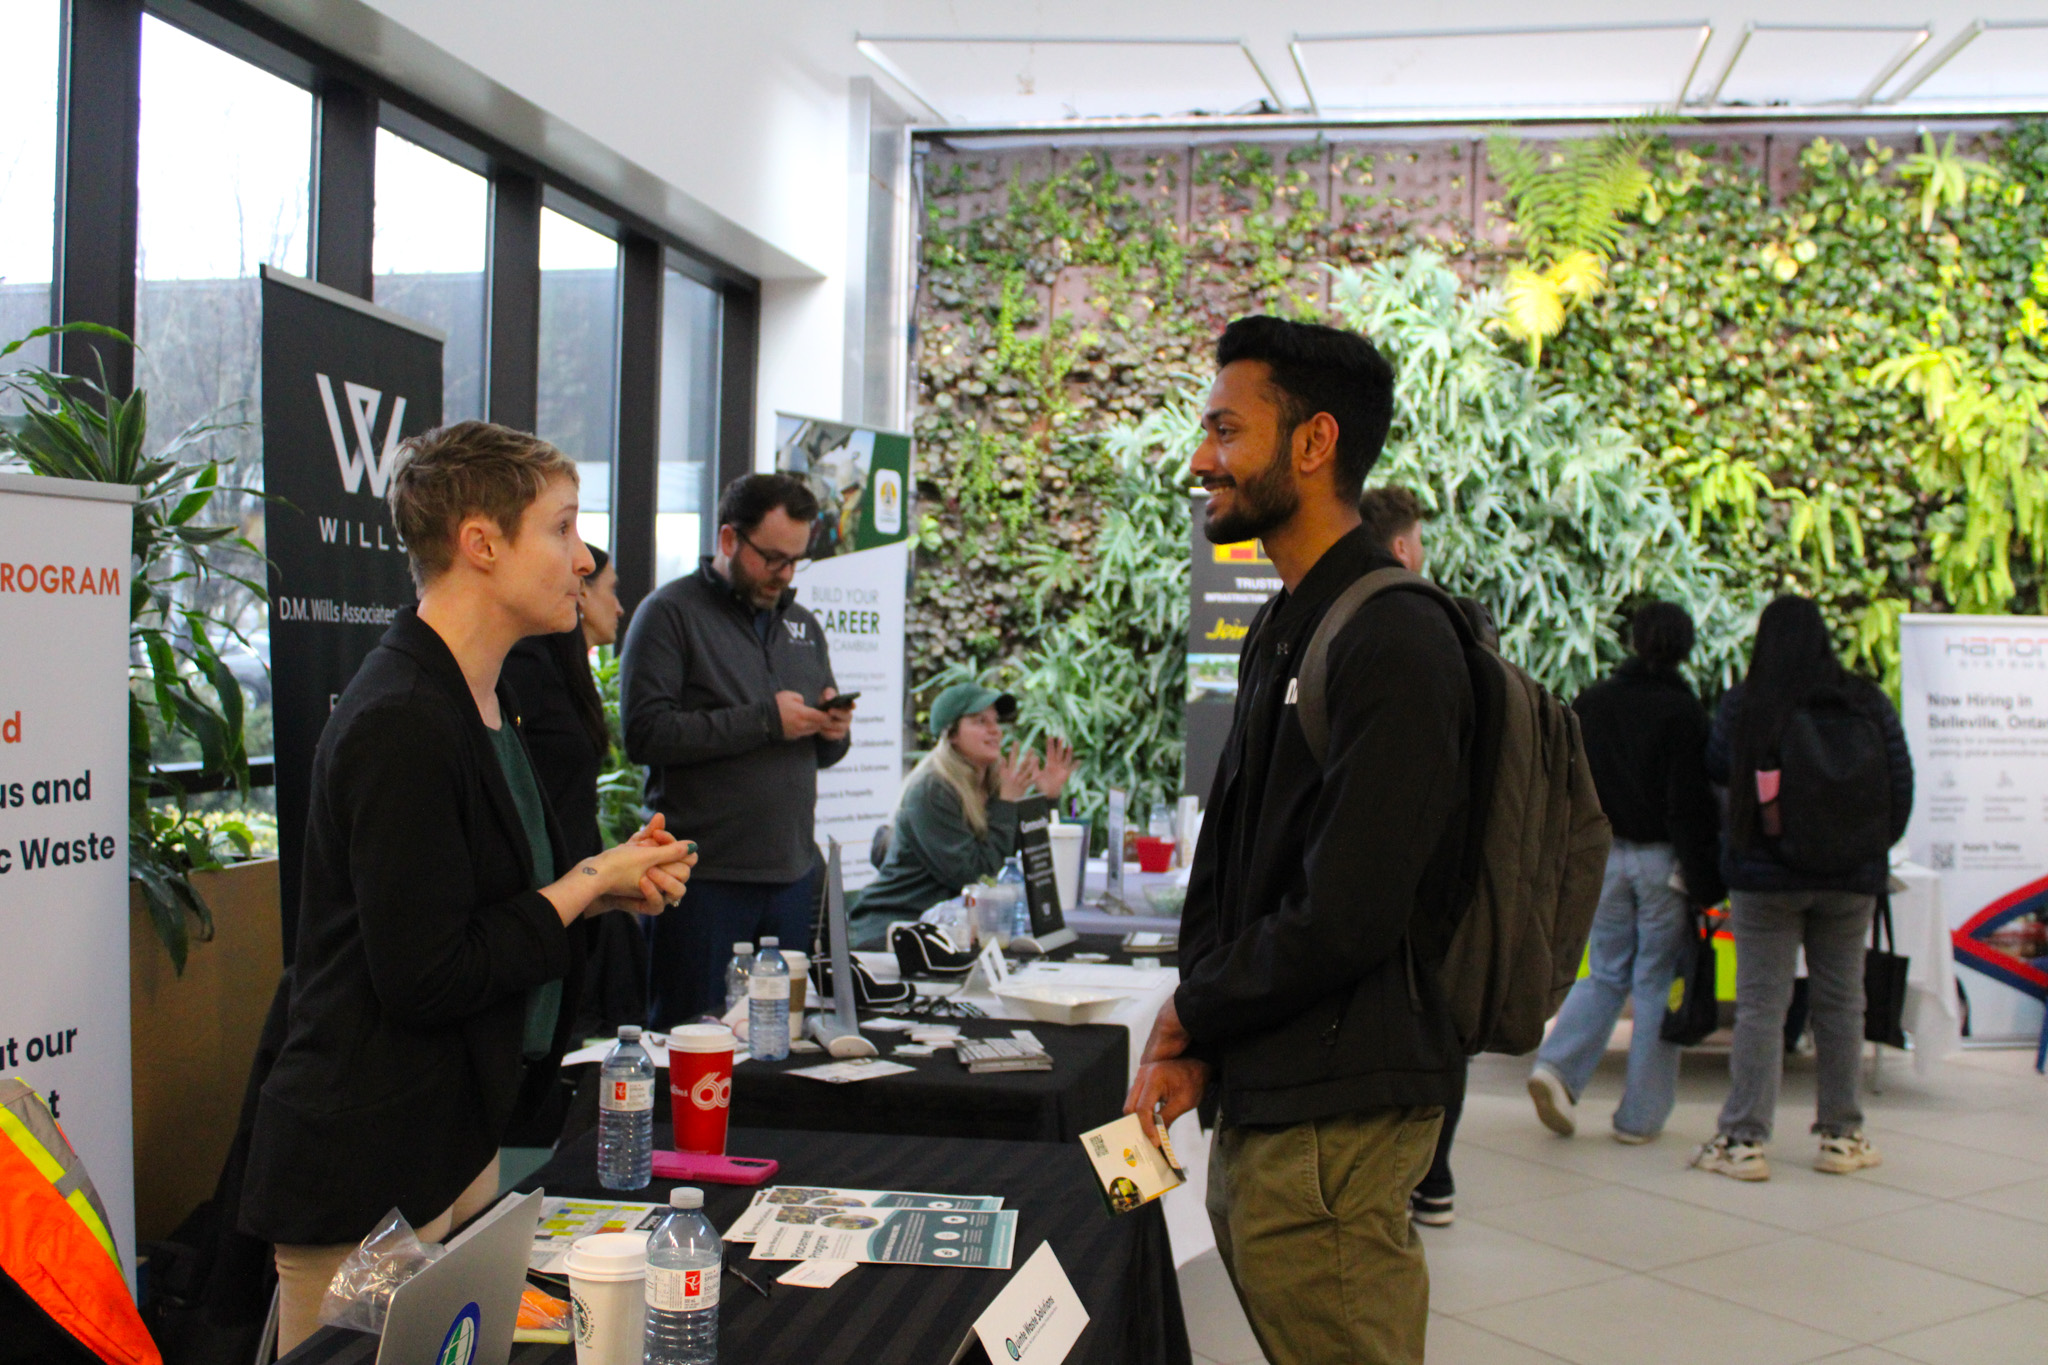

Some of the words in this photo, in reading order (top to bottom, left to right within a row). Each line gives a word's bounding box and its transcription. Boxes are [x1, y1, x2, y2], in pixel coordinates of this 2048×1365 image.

[812, 586, 842, 602] BUILD
[845, 588, 879, 604] YOUR
[1234, 577, 1284, 591] TRUSTE
[279, 596, 310, 621] D.M.
[311, 598, 340, 622] Wills
[1927, 692, 1962, 707] Now
[1966, 692, 2013, 710] Hiring
[2017, 692, 2033, 707] in
[32, 769, 91, 805] and
[20, 831, 116, 871] Waste
[26, 1027, 78, 1063] our
[691, 1071, 732, 1111] 60
[790, 1230, 814, 1259] Placement
[808, 1235, 830, 1259] Program
[1024, 1315, 1039, 1336] Waste
[1034, 1295, 1055, 1322] Solutions
